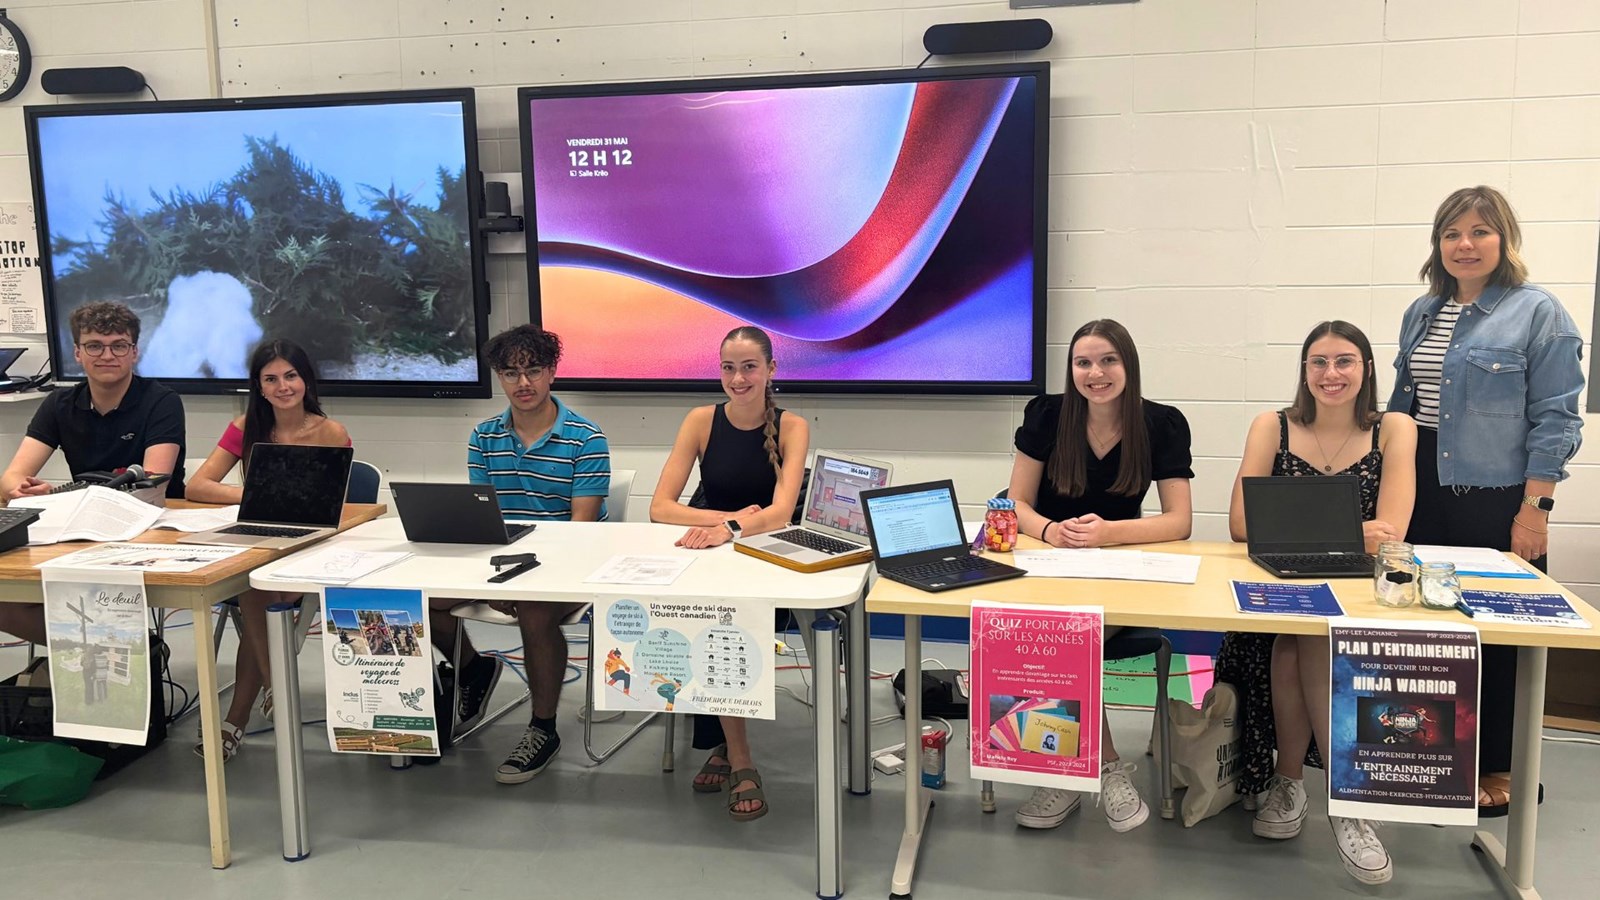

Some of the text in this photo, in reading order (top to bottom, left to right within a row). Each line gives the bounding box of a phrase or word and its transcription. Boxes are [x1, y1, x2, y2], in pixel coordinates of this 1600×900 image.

[567, 138, 602, 147] VENDREDI
[613, 137, 628, 145] MAI
[568, 149, 632, 167] 12 H 12
[0, 257, 41, 268] OTION
[96, 591, 142, 606] Le deuil
[650, 602, 660, 610] Un
[662, 604, 691, 612] voyage
[704, 604, 716, 612] ski
[680, 612, 717, 620] canadien
[990, 617, 1081, 631] QUIZ PORTANT
[988, 630, 1084, 645] SUR LES ANNÉES
[1015, 643, 1057, 656] 40 À 60
[1338, 640, 1476, 659] PLAN D'ENTRAINEMENT
[354, 657, 405, 667] Itinéraire de
[1361, 662, 1381, 670] POUR
[1383, 663, 1417, 671] DEVENIR
[1432, 665, 1449, 673] BON
[361, 667, 401, 678] voyage de
[362, 676, 400, 685] motocross
[1353, 676, 1457, 695] NINJA WARRIOR
[1023, 688, 1045, 696] Produit:
[1035, 718, 1072, 734] Johnny Cash
[1359, 749, 1370, 757] EN
[1371, 750, 1416, 760] APPRENDRE
[1438, 754, 1453, 762] SUR
[1355, 761, 1453, 776] L'ENTRAINEMENT
[1370, 770, 1437, 784] NÉCESSAIRE
